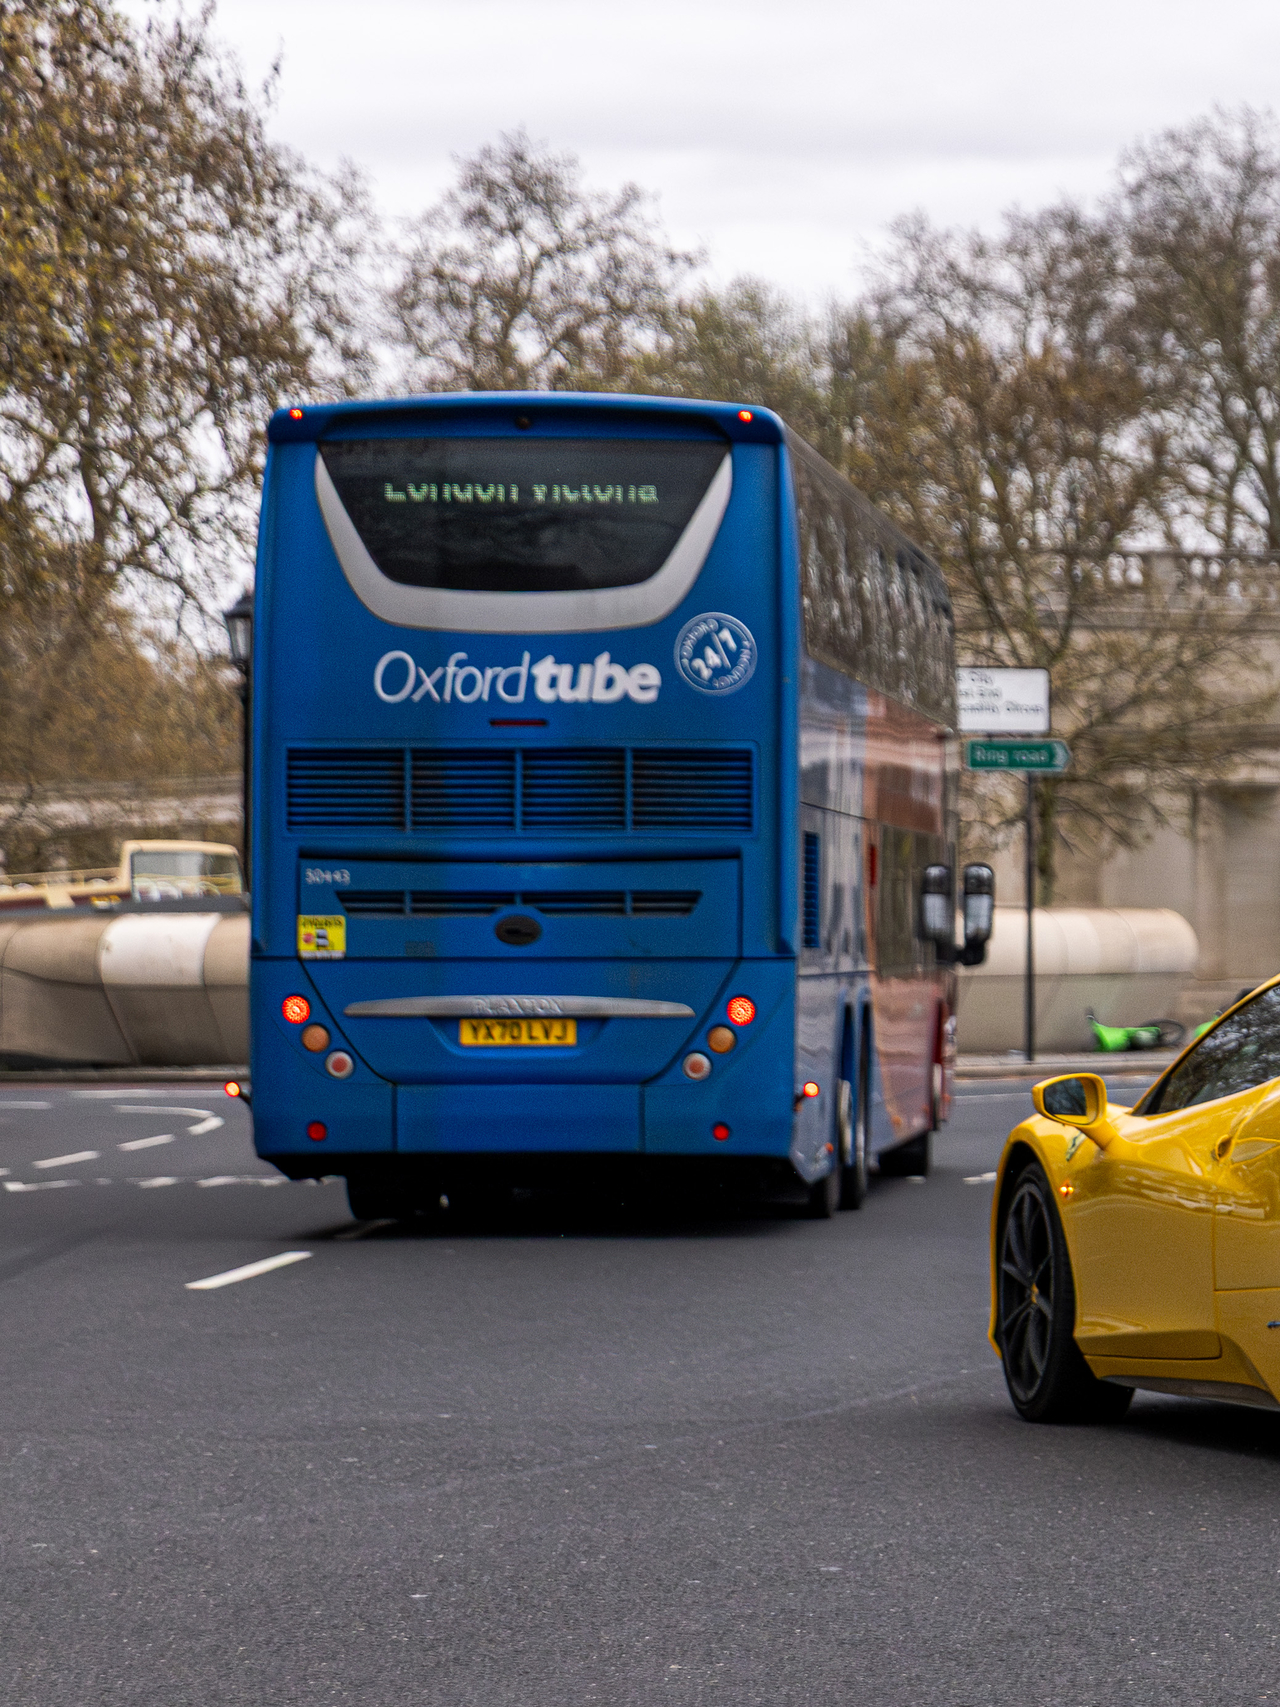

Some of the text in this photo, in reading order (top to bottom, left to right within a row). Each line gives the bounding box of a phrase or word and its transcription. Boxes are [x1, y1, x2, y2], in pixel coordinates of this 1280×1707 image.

[680, 618, 719, 661] OXFORD
[690, 626, 738, 682] 24/7
[975, 746, 1048, 765] Ring road
[468, 1020, 568, 1041] YX70 LVJ
